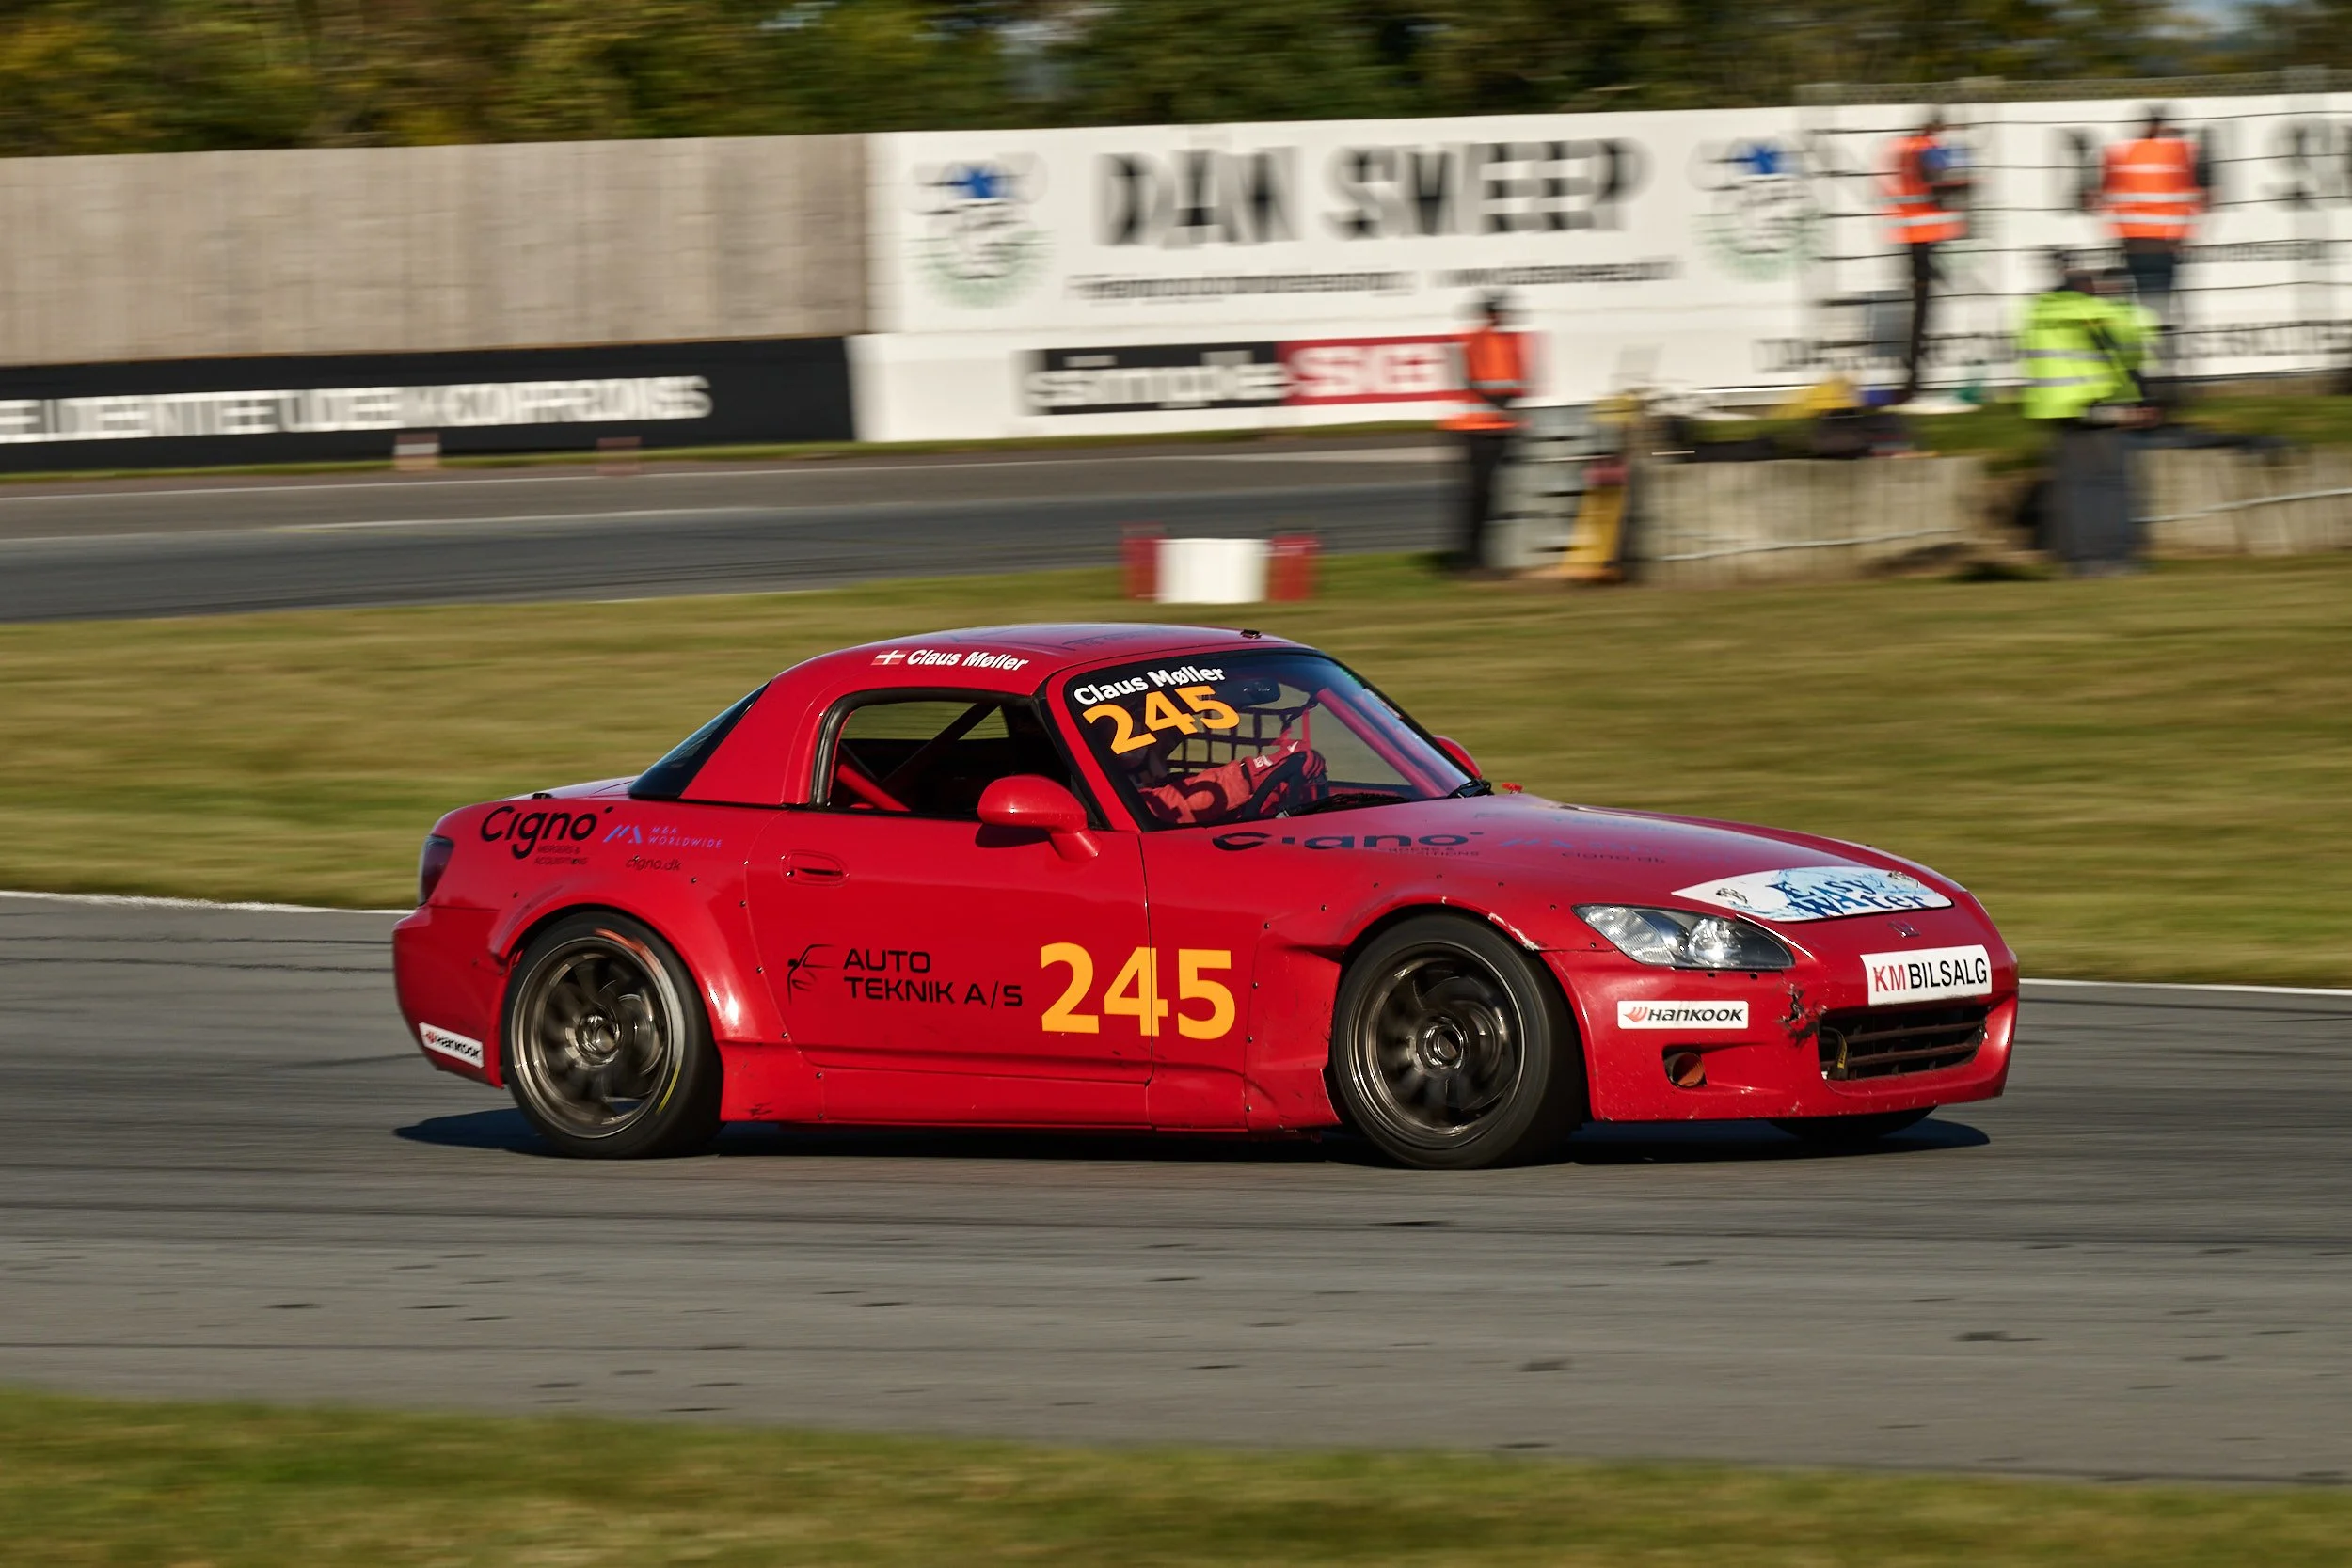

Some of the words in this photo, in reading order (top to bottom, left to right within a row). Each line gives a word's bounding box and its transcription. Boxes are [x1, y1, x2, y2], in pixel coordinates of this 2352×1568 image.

[907, 649, 962, 666] Claus
[961, 651, 1029, 671] Møller
[1073, 675, 1149, 705] Claus
[1147, 665, 1225, 687] Møller
[1082, 685, 1241, 755] 245
[481, 806, 597, 860] Cigno
[843, 948, 930, 974] AUTO
[843, 976, 955, 1005] TEKNIK
[963, 981, 1023, 1009] A/S
[1040, 942, 1237, 1040] 245
